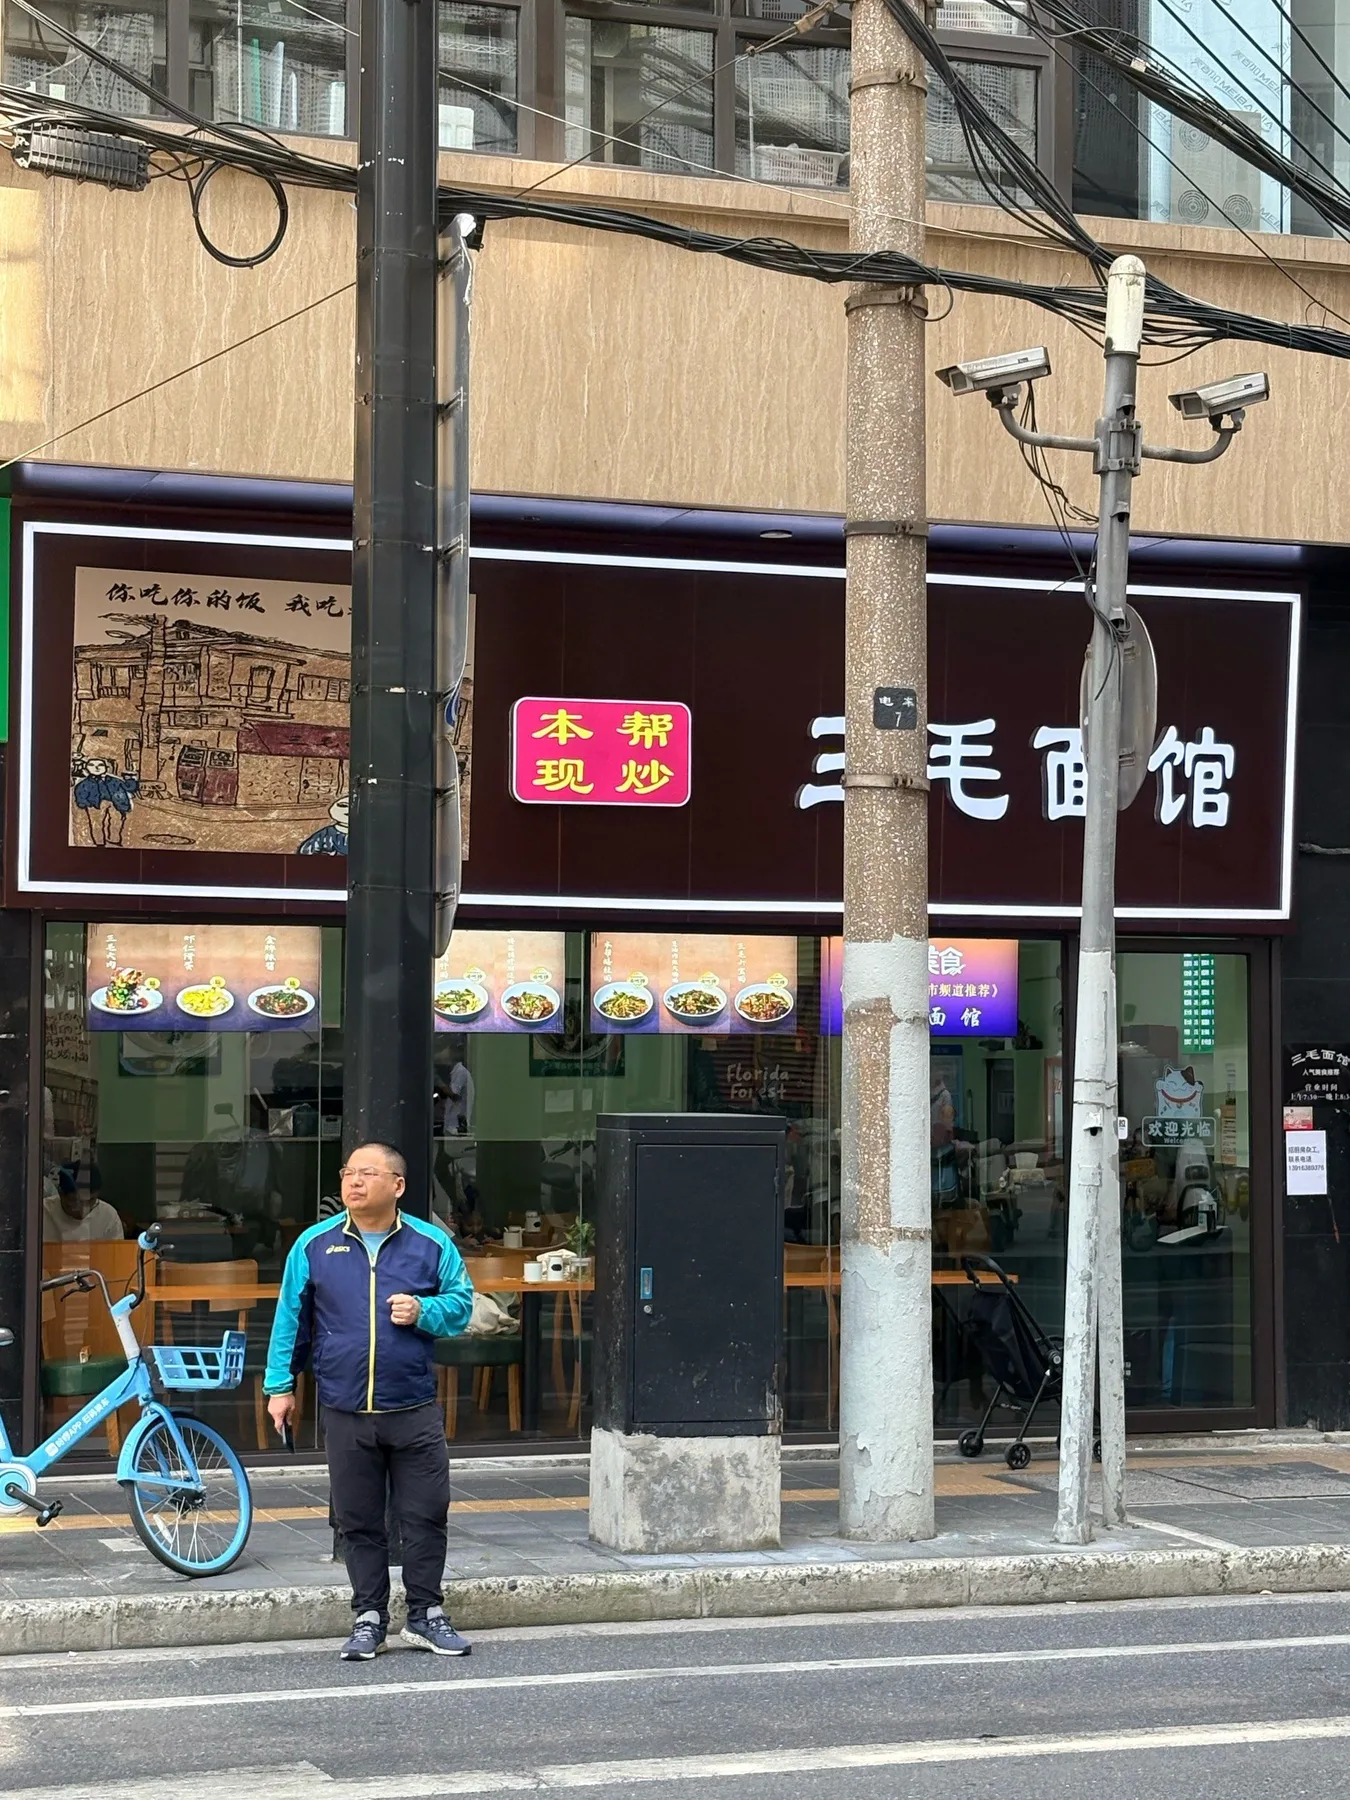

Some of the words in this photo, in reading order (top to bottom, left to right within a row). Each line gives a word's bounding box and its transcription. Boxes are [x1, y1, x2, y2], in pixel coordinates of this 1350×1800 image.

[105, 582, 266, 614] 你吃你的饭
[284, 593, 352, 618] 我吃
[531, 708, 674, 750] 本帮
[895, 711, 902, 728] 7
[531, 758, 675, 795] 现炒
[726, 1062, 790, 1082] Florida
[1147, 1120, 1212, 1138] 欢迎光临
